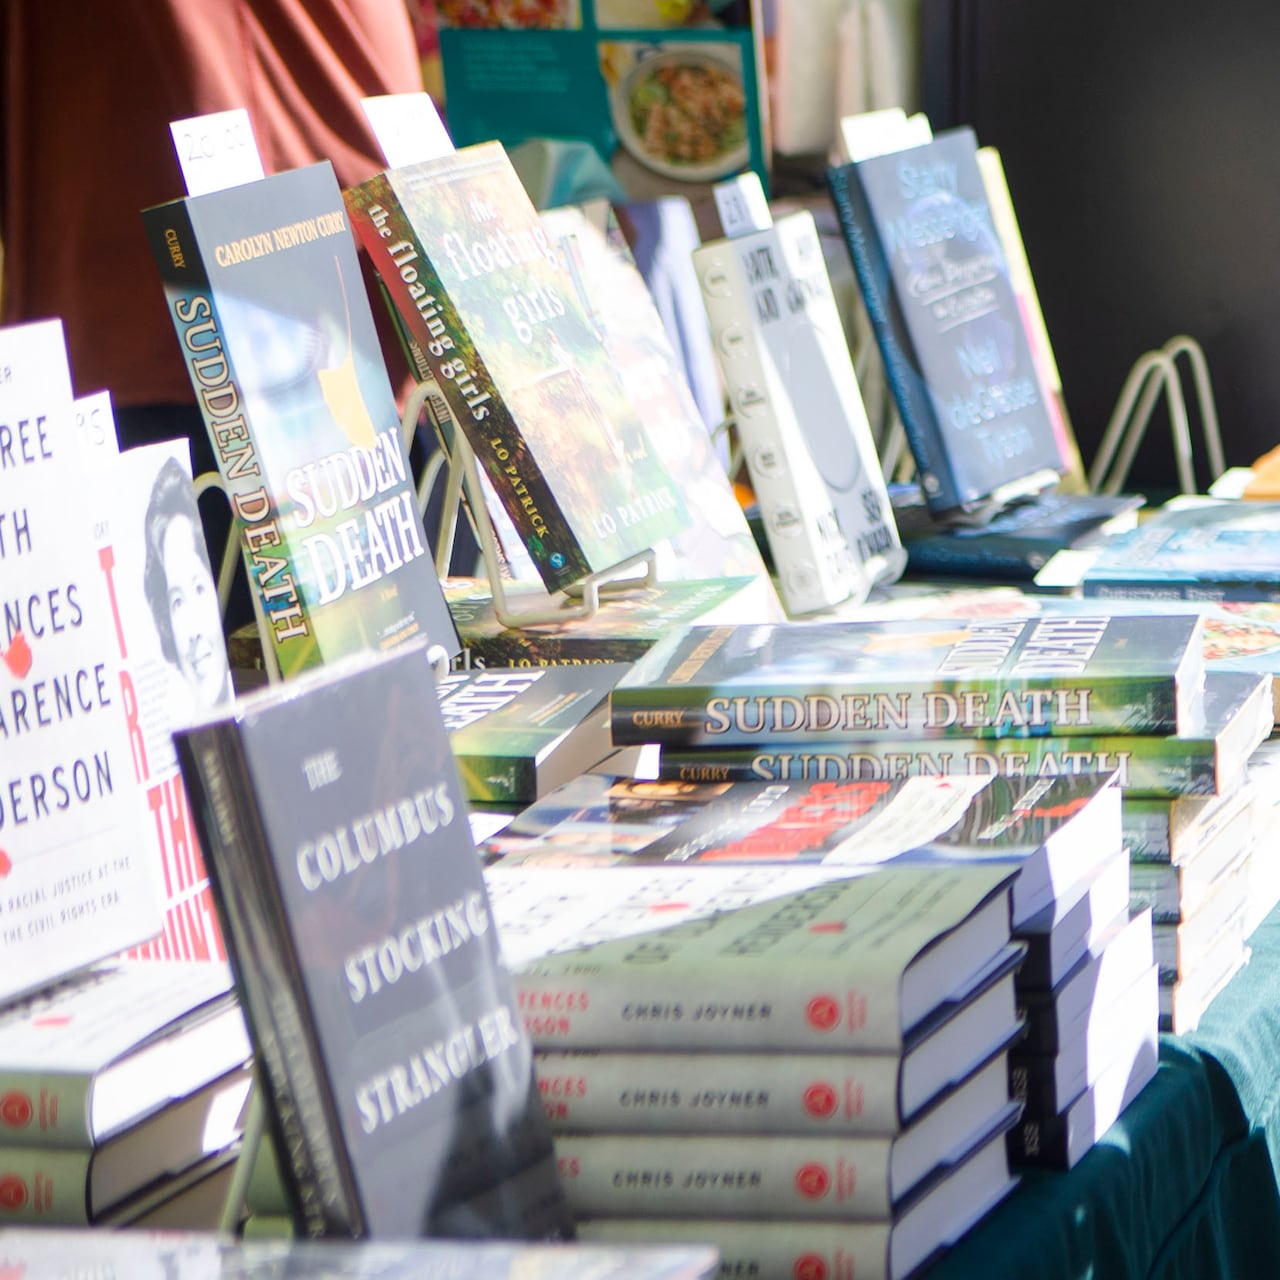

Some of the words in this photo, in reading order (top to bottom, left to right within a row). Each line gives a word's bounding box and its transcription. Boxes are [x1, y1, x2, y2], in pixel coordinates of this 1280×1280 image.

[163, 228, 187, 269] CURRY
[214, 230, 275, 269] CAROLYN
[273, 218, 319, 252] NEWTON
[317, 210, 347, 238] CURRY
[441, 225, 560, 283] floating
[368, 204, 392, 239] the
[387, 240, 456, 357] floating
[440, 356, 490, 421] girls
[502, 273, 566, 345] girls
[175, 295, 261, 481] SUDDEN
[234, 486, 309, 644] DEATH
[287, 426, 407, 529] SUDDEN
[490, 437, 510, 461] LO
[506, 464, 550, 539] PATRICK
[616, 486, 679, 524] PATRICK
[302, 489, 426, 607] DEATH
[633, 710, 684, 726] CURRY
[705, 692, 911, 735] SUDDEN
[923, 688, 1093, 732] DEATH
[302, 749, 343, 792] THE
[680, 767, 731, 782] CURRY
[751, 753, 954, 782] SUDDEN
[964, 751, 1133, 788] DEATH
[296, 781, 455, 892] COLUMBUS
[344, 890, 490, 1004] STOCKING
[621, 1003, 683, 1020] CHRIS
[692, 1003, 773, 1020] JOYNER
[355, 1004, 519, 1135] STRANGLER
[619, 1089, 681, 1107] CHRIS
[690, 1089, 770, 1107] JOYNER
[612, 1171, 674, 1189] CHRIS
[682, 1171, 762, 1189] JOYNER
